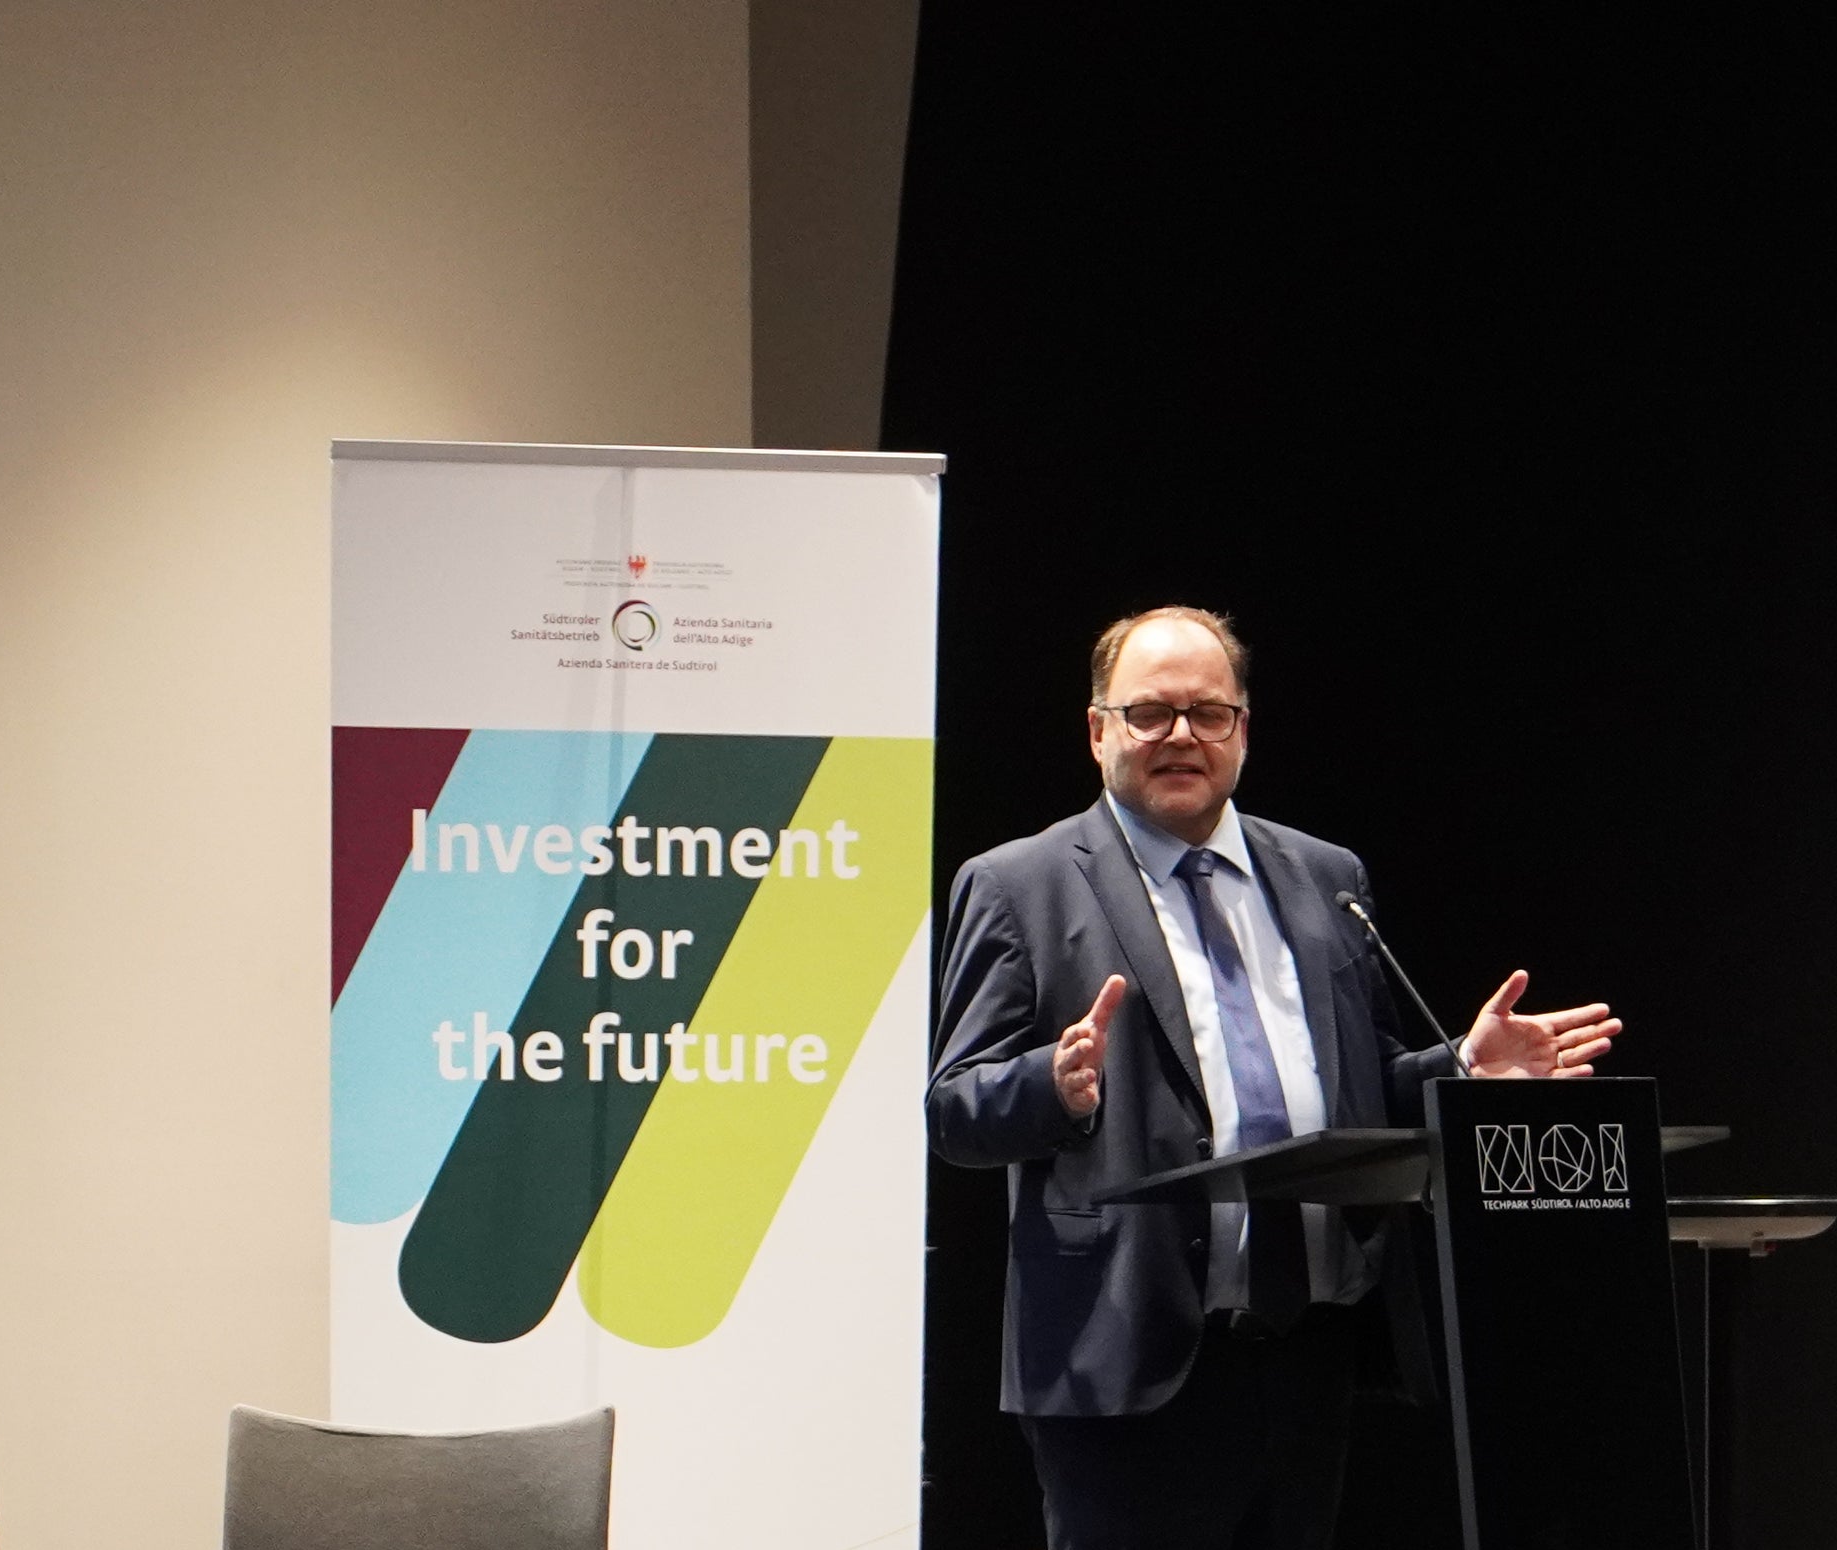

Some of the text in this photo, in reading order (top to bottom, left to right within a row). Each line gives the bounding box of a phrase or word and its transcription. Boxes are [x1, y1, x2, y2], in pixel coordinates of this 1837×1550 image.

[673, 617, 773, 630] Azienda Sanitaria
[510, 629, 600, 641] Sanitätsbetrieb
[673, 633, 754, 647] dell'Alto Adige
[557, 658, 603, 669] Azienda
[605, 659, 653, 670] Sanitera
[656, 660, 670, 670] de
[411, 807, 861, 879] Investment
[576, 908, 694, 980] for
[432, 1011, 829, 1084] the future
[1475, 1123, 1629, 1193] NOI
[1483, 1200, 1530, 1210] TECHPARK
[1531, 1197, 1574, 1209] SÜDTIROL
